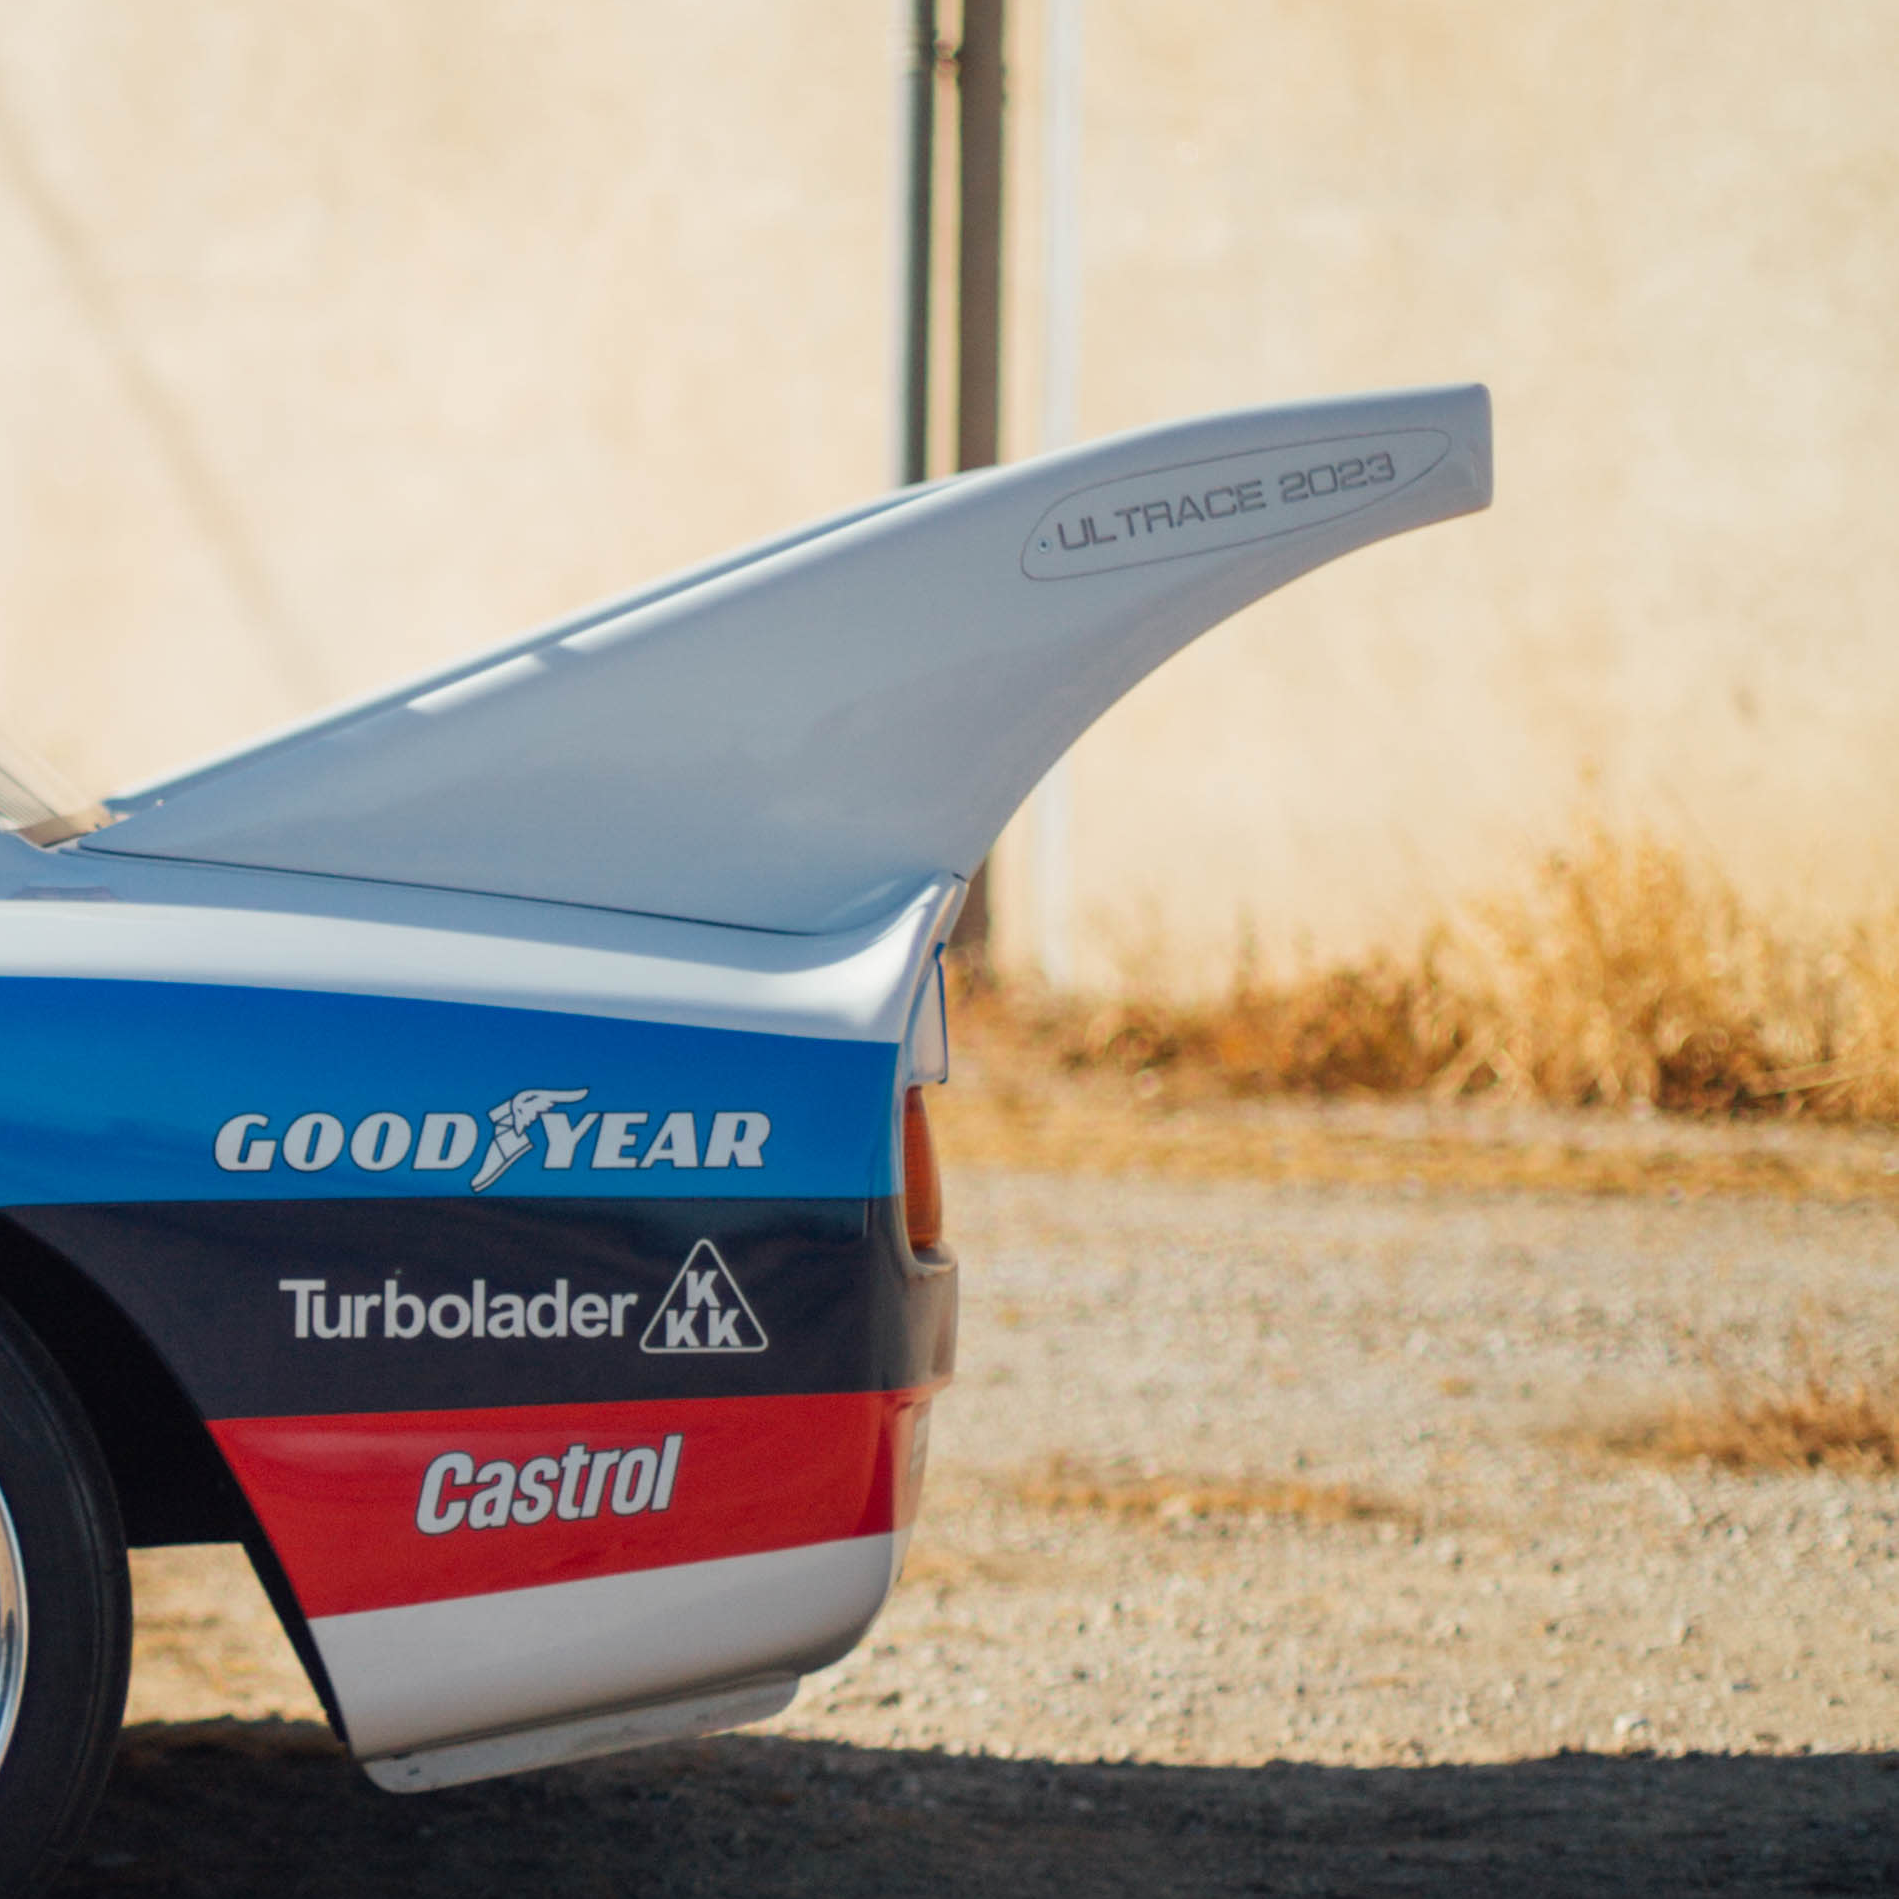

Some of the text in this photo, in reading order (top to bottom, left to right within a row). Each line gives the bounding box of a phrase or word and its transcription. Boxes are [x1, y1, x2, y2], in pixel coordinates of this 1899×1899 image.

[1056, 450, 1396, 552] ULTRACE 2023
[279, 1278, 639, 1339] Turbolader
[415, 1433, 684, 1536] Castrol
